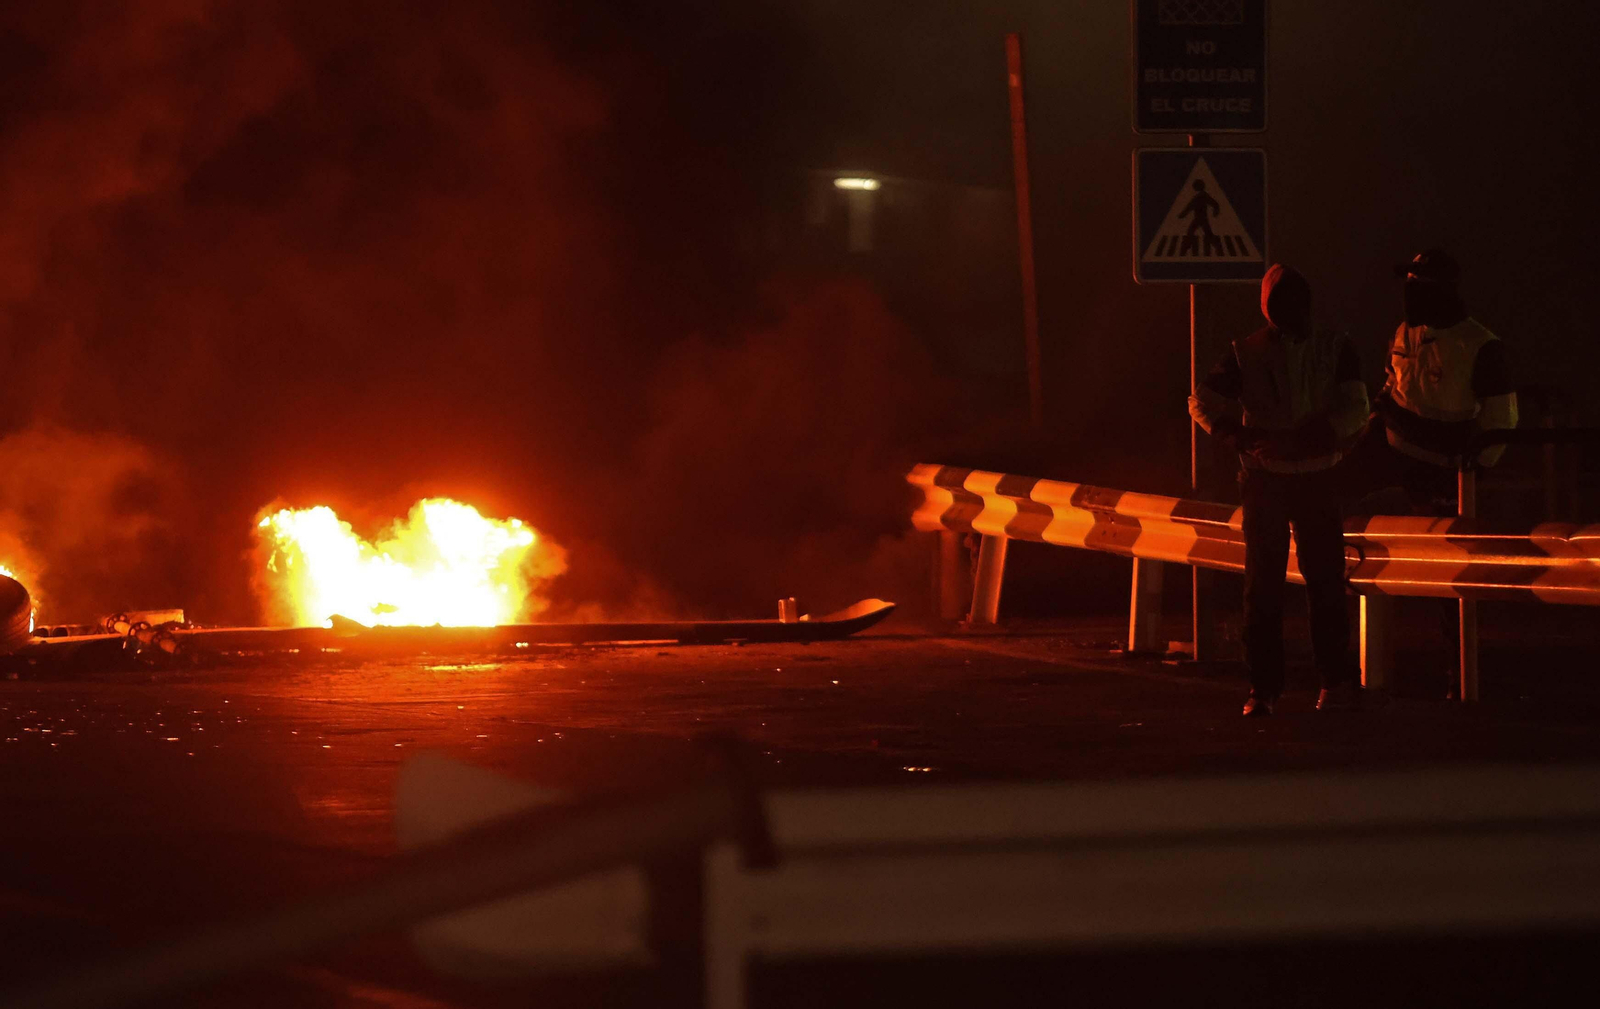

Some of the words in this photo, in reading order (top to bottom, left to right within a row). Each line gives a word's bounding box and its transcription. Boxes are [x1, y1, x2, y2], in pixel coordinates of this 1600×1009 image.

[1186, 41, 1216, 54] NO
[1144, 68, 1256, 82] BLOQUEAR
[1151, 98, 1175, 112] EL
[1182, 98, 1252, 112] CRUCE
